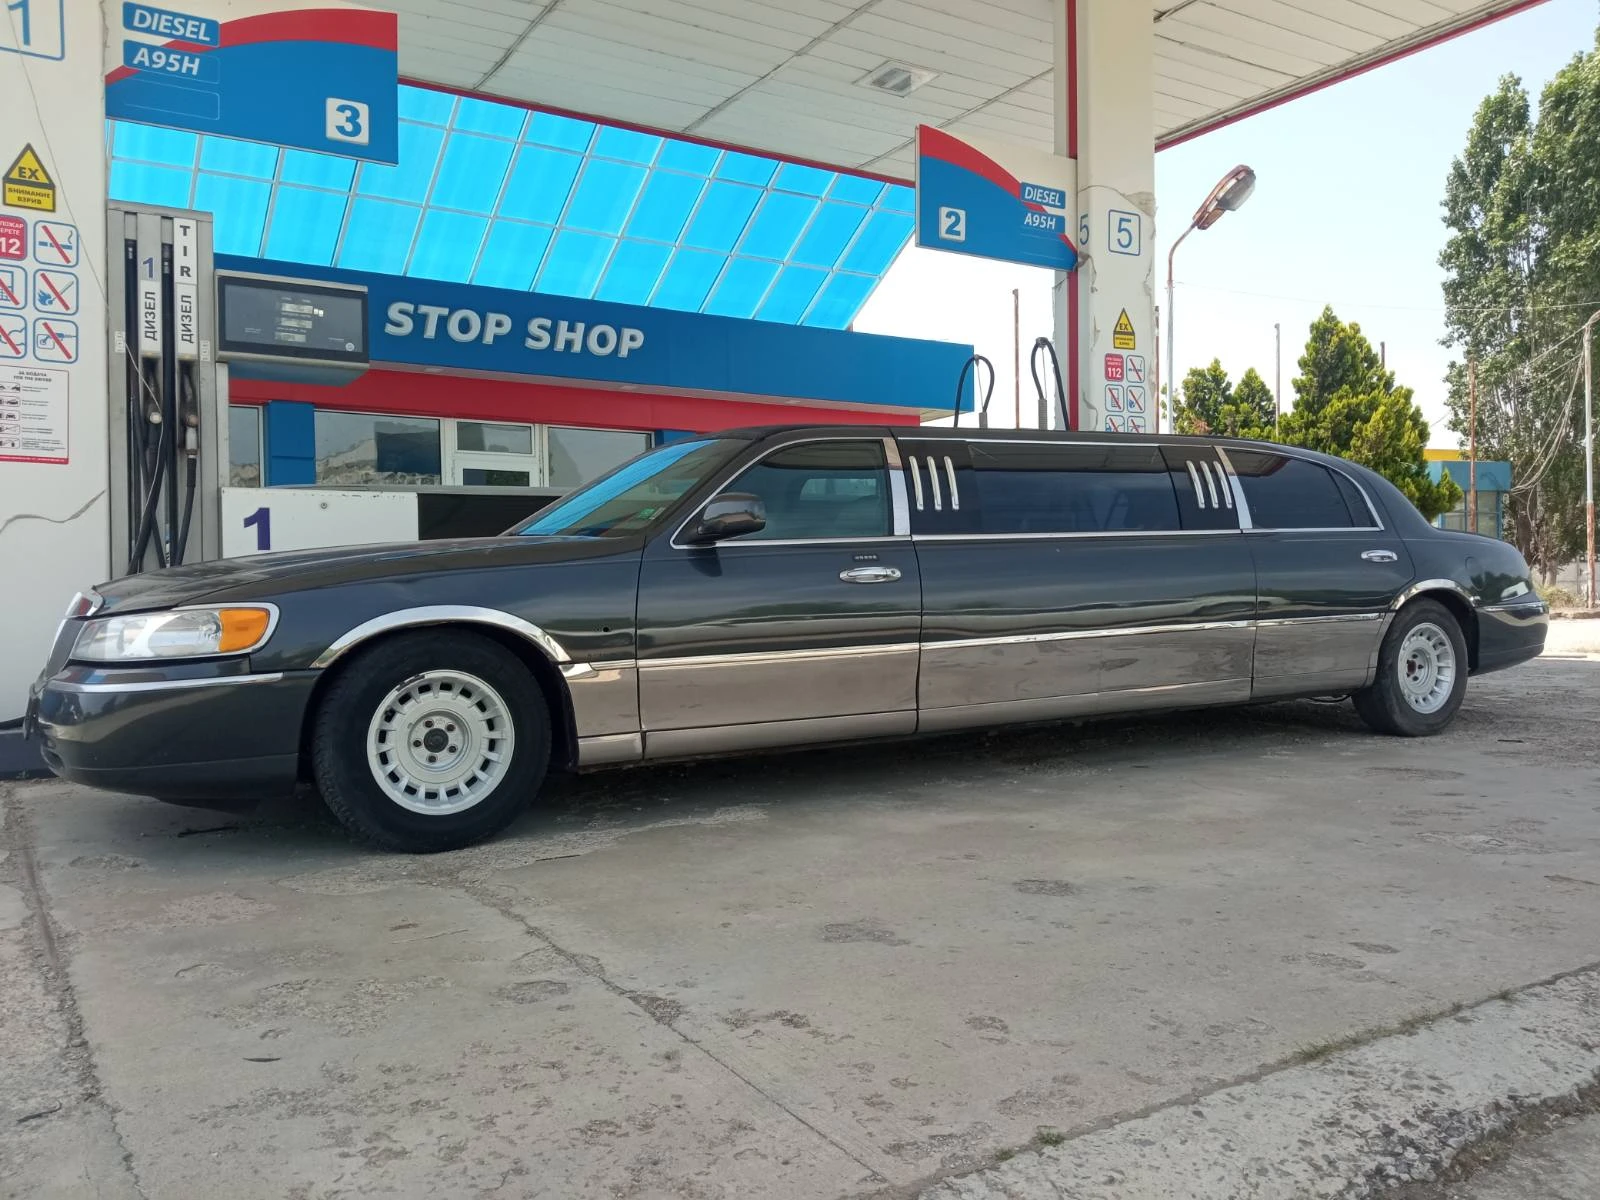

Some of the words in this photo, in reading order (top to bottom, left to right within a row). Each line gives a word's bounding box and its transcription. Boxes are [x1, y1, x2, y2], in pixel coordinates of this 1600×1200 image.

[133, 8, 211, 42] DIESEL
[133, 47, 201, 76] A95H
[335, 104, 362, 138] 3
[18, 166, 40, 181] EX
[1024, 187, 1062, 207] DIESEL
[944, 210, 962, 237] 2
[1024, 212, 1057, 230] A95H
[1116, 217, 1133, 249] 5
[142, 257, 155, 279] 1
[144, 291, 158, 341] ДИЗЕЛ
[181, 295, 194, 344] ДИЗЕЛ
[384, 302, 511, 345] STOP
[524, 317, 645, 359] SHOP
[1119, 322, 1129, 331] EX
[1107, 367, 1122, 378] 112
[243, 506, 272, 551] 1
